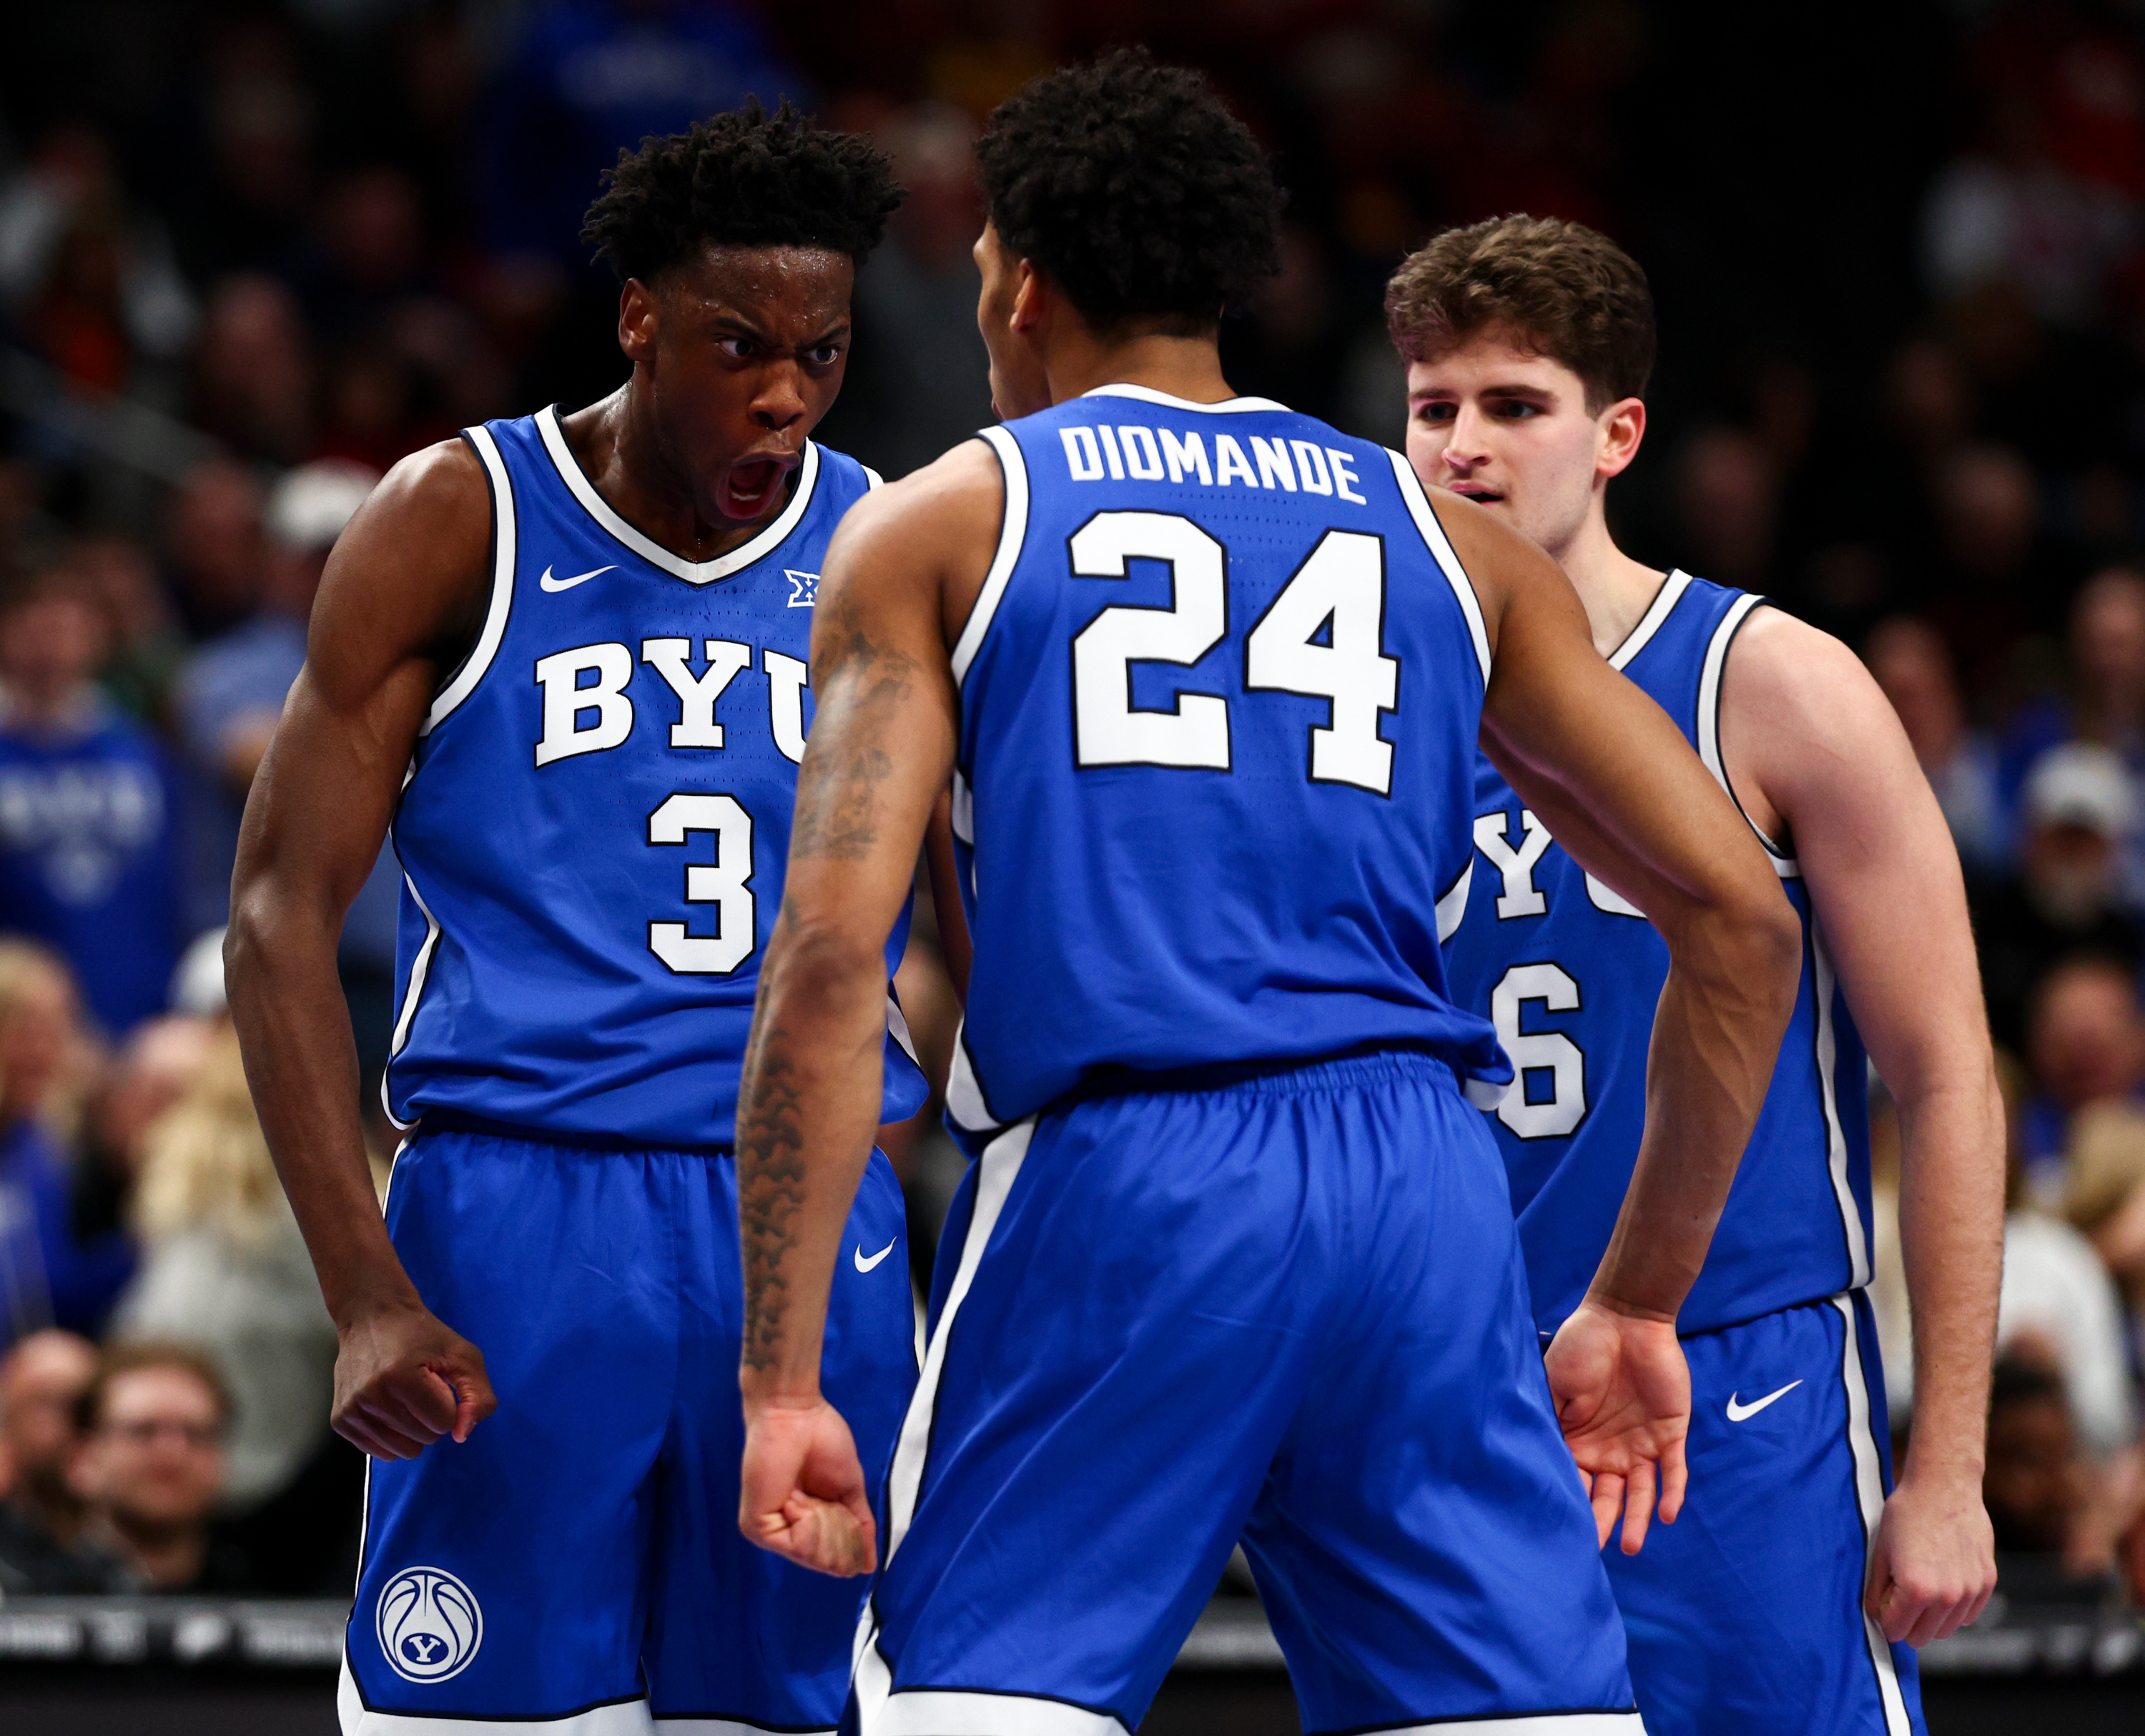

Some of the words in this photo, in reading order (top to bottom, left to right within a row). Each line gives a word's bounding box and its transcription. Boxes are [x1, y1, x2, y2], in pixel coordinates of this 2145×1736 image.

[1059, 425, 1367, 505] DIOMANDE
[1066, 509, 1402, 799] 24
[646, 791, 756, 976] 3
[1490, 960, 1587, 1142] 6
[408, 1635, 441, 1662] Y
